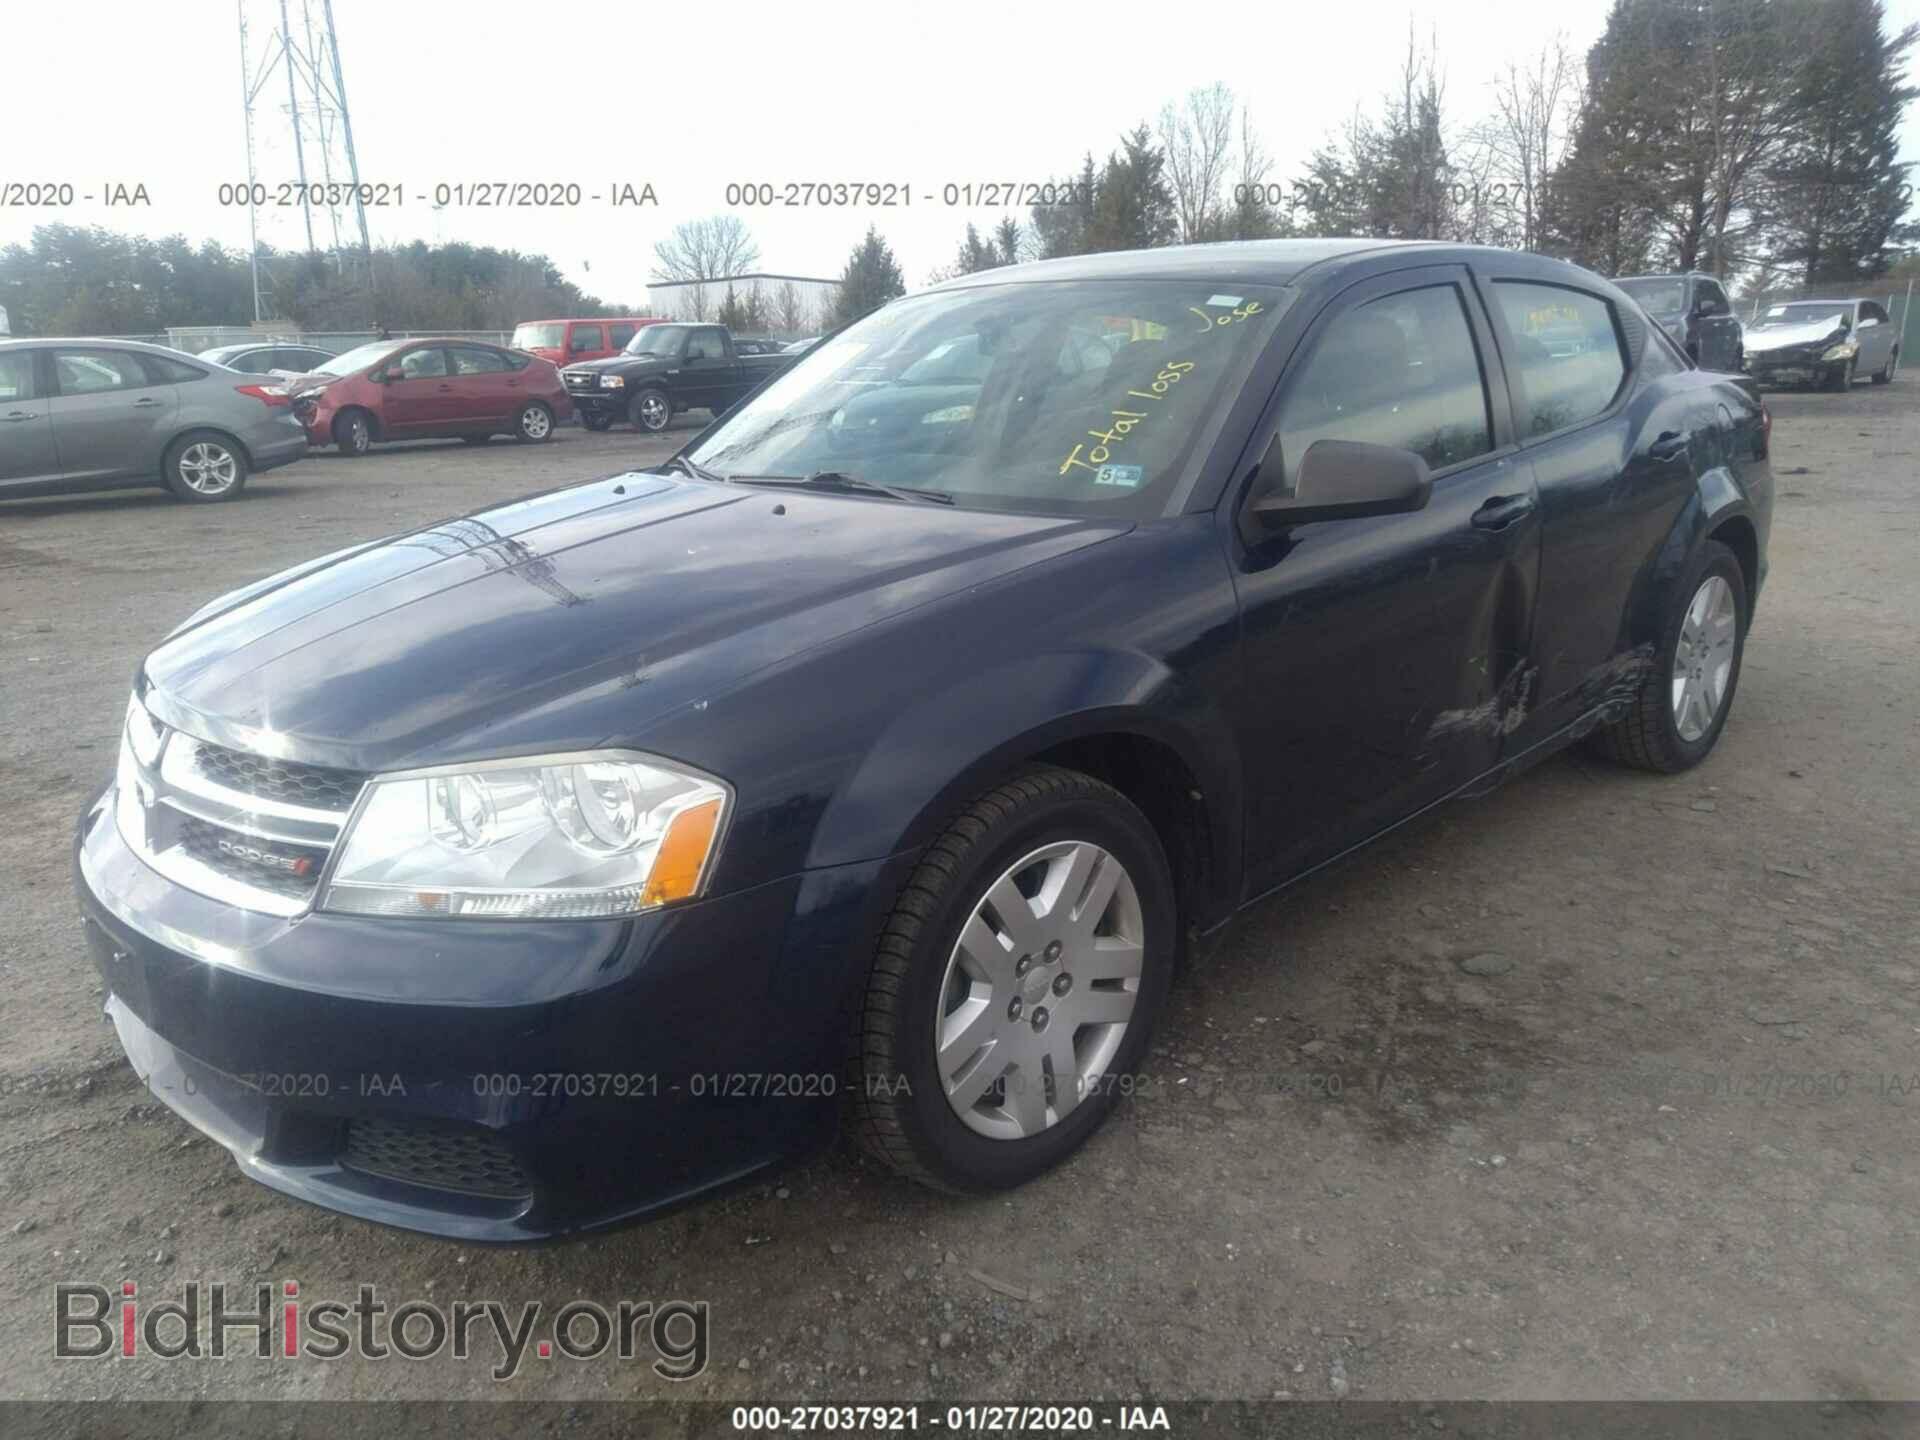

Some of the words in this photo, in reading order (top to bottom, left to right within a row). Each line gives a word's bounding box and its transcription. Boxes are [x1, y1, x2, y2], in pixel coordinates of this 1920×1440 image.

[1188, 301, 1265, 334] Jose
[1058, 410, 1148, 476] Total
[1101, 467, 1113, 482] 5
